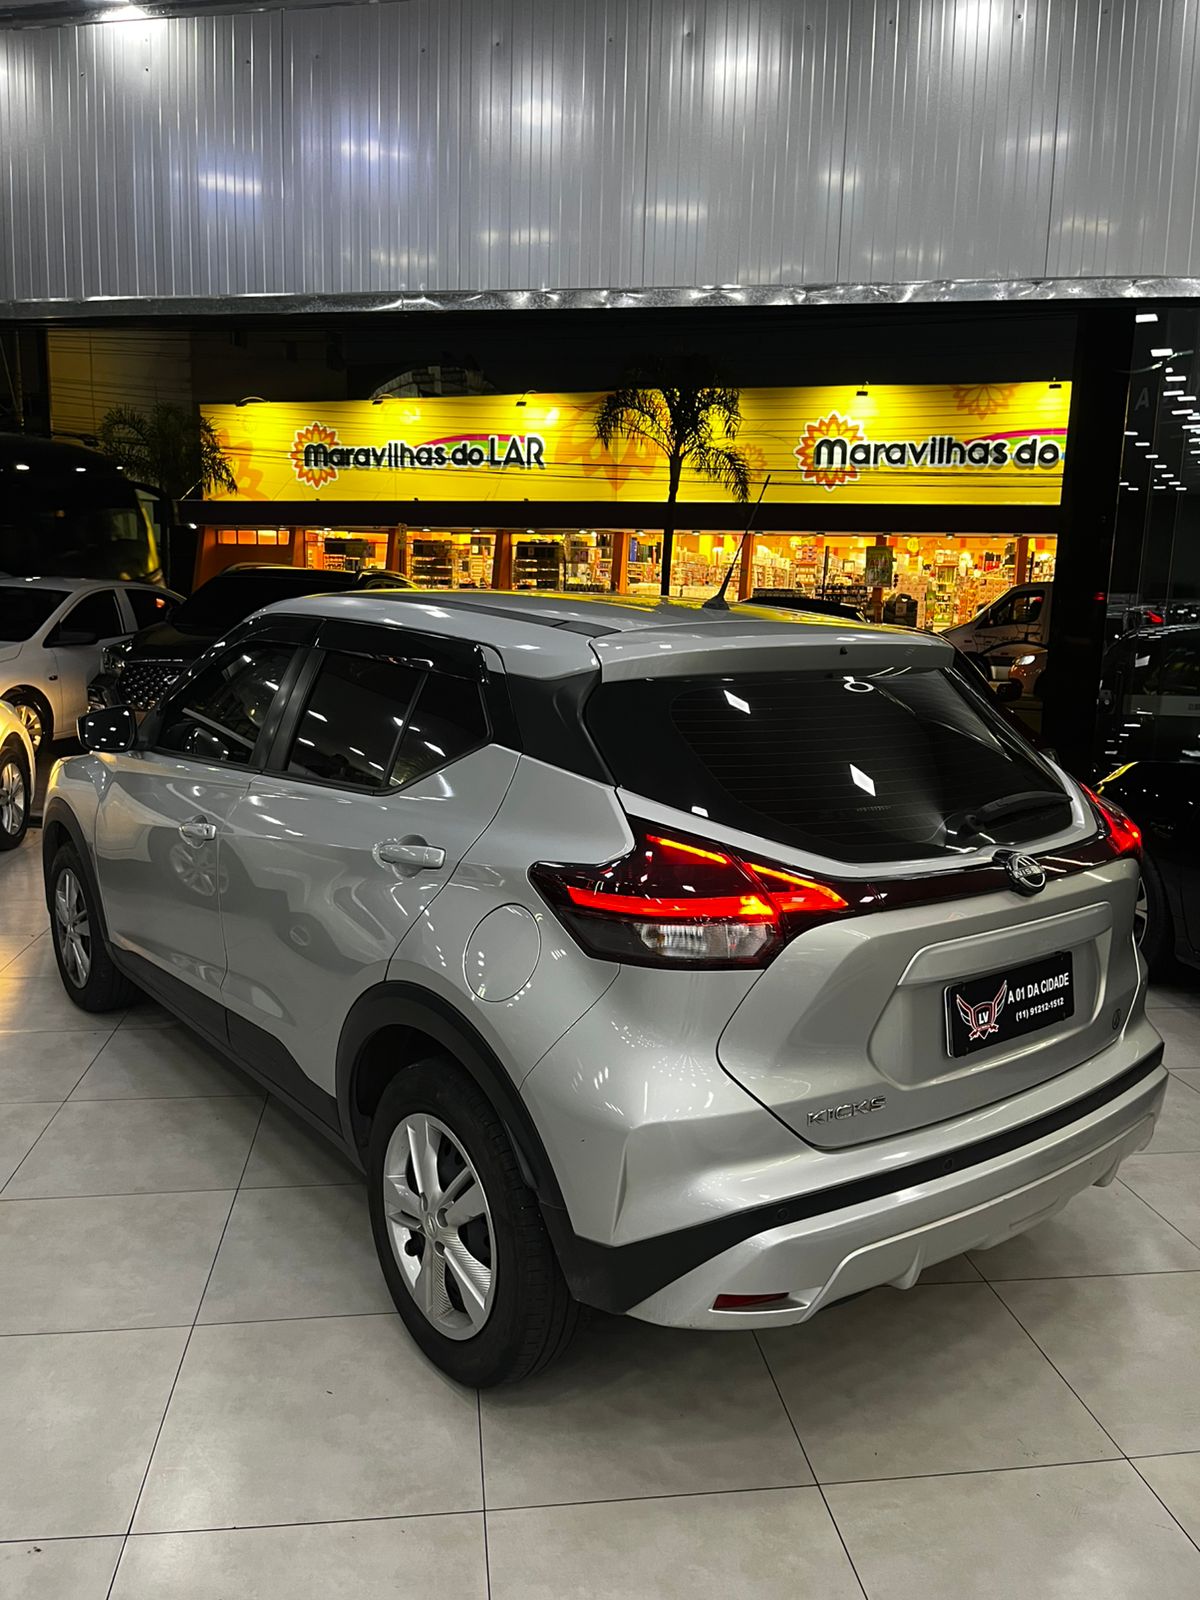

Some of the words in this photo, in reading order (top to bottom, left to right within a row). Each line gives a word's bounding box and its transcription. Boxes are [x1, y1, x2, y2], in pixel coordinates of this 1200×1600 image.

[304, 441, 448, 470] Maravilhas
[451, 442, 485, 467] do
[489, 436, 546, 470] LAR
[814, 437, 1007, 468] Maravilhas
[1013, 438, 1060, 468] do
[1007, 990, 1015, 1004] A
[1016, 987, 1026, 1002] 01
[1027, 983, 1040, 998] DA
[1040, 972, 1070, 994] CIDADE
[978, 1011, 990, 1025] LV
[1015, 1010, 1029, 1022] (11)
[1030, 997, 1065, 1016] 91212-1512
[807, 1095, 887, 1126] KICKS
